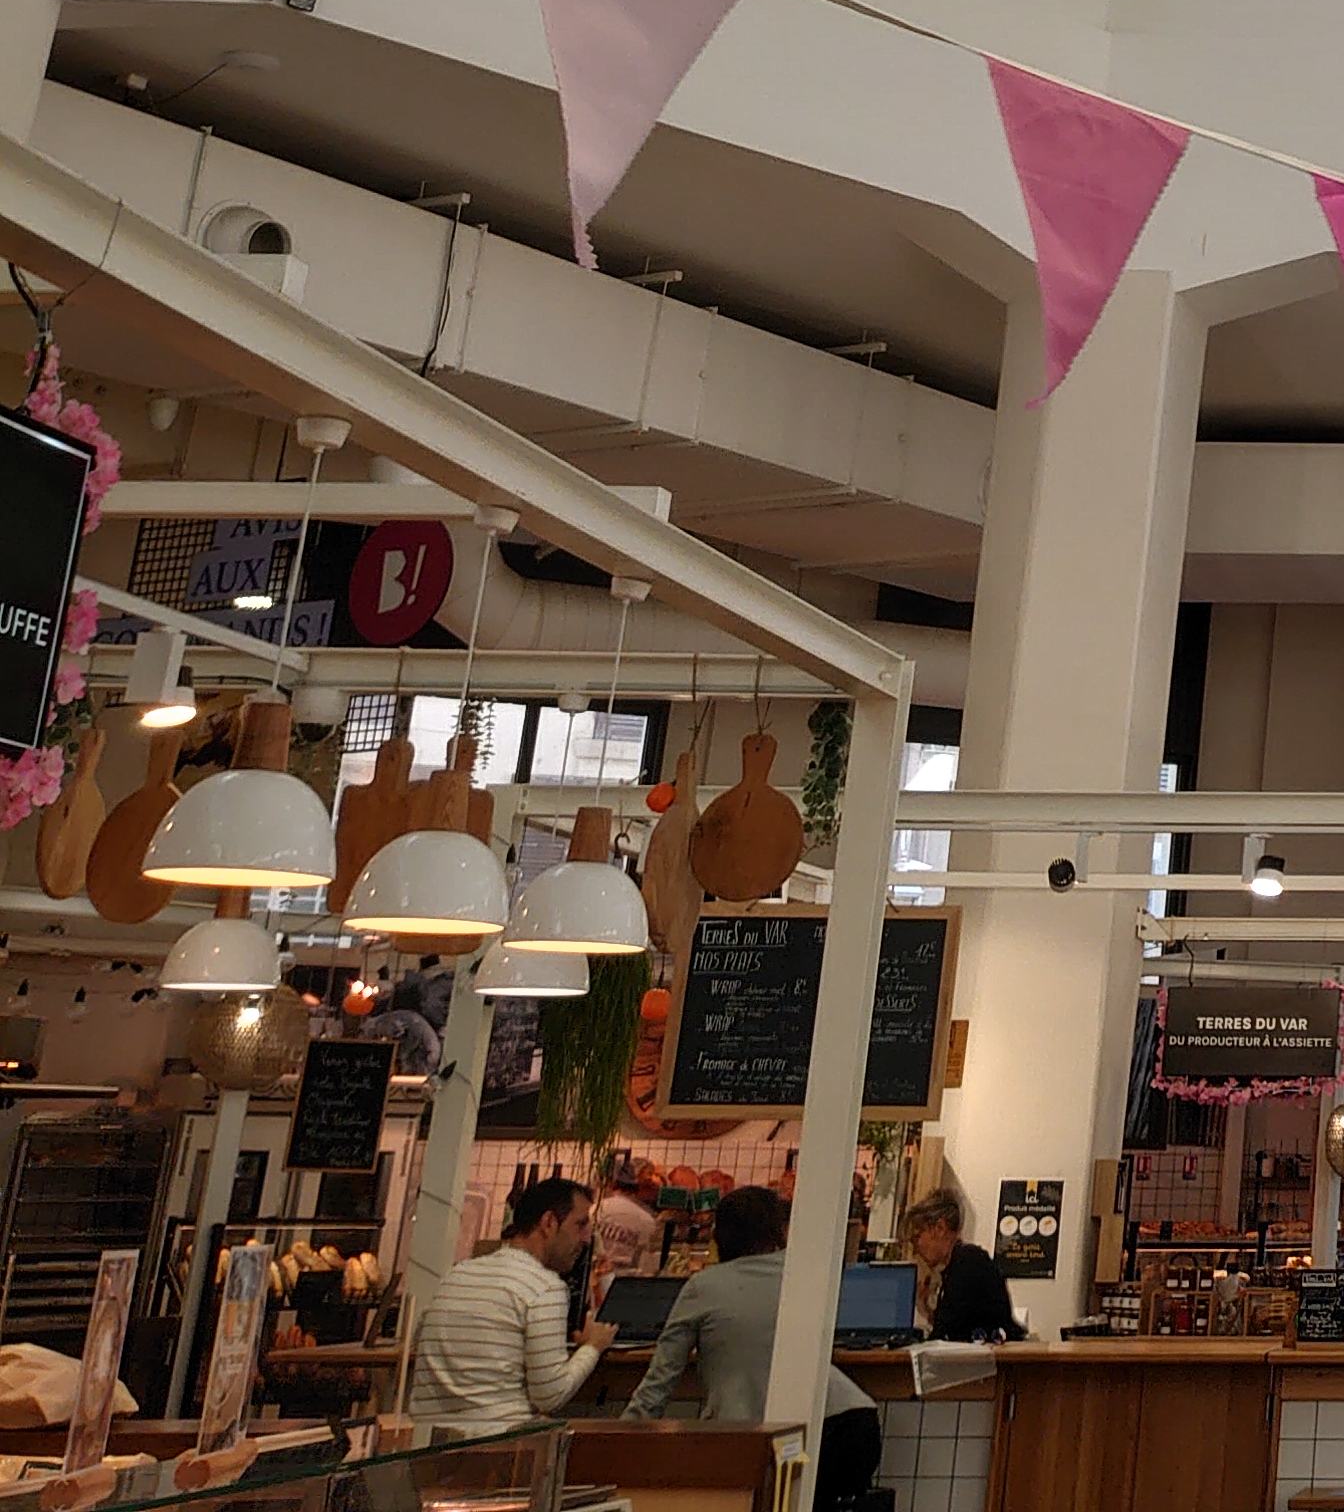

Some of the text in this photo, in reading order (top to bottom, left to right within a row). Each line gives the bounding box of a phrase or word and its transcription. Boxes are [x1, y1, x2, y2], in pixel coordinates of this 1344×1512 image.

[191, 557, 269, 598] AUX
[1197, 1016, 1308, 1031] TERRES DU VAR
[1169, 1034, 1332, 1048] DU PRODUCTEUR À L'ASSIETTE
